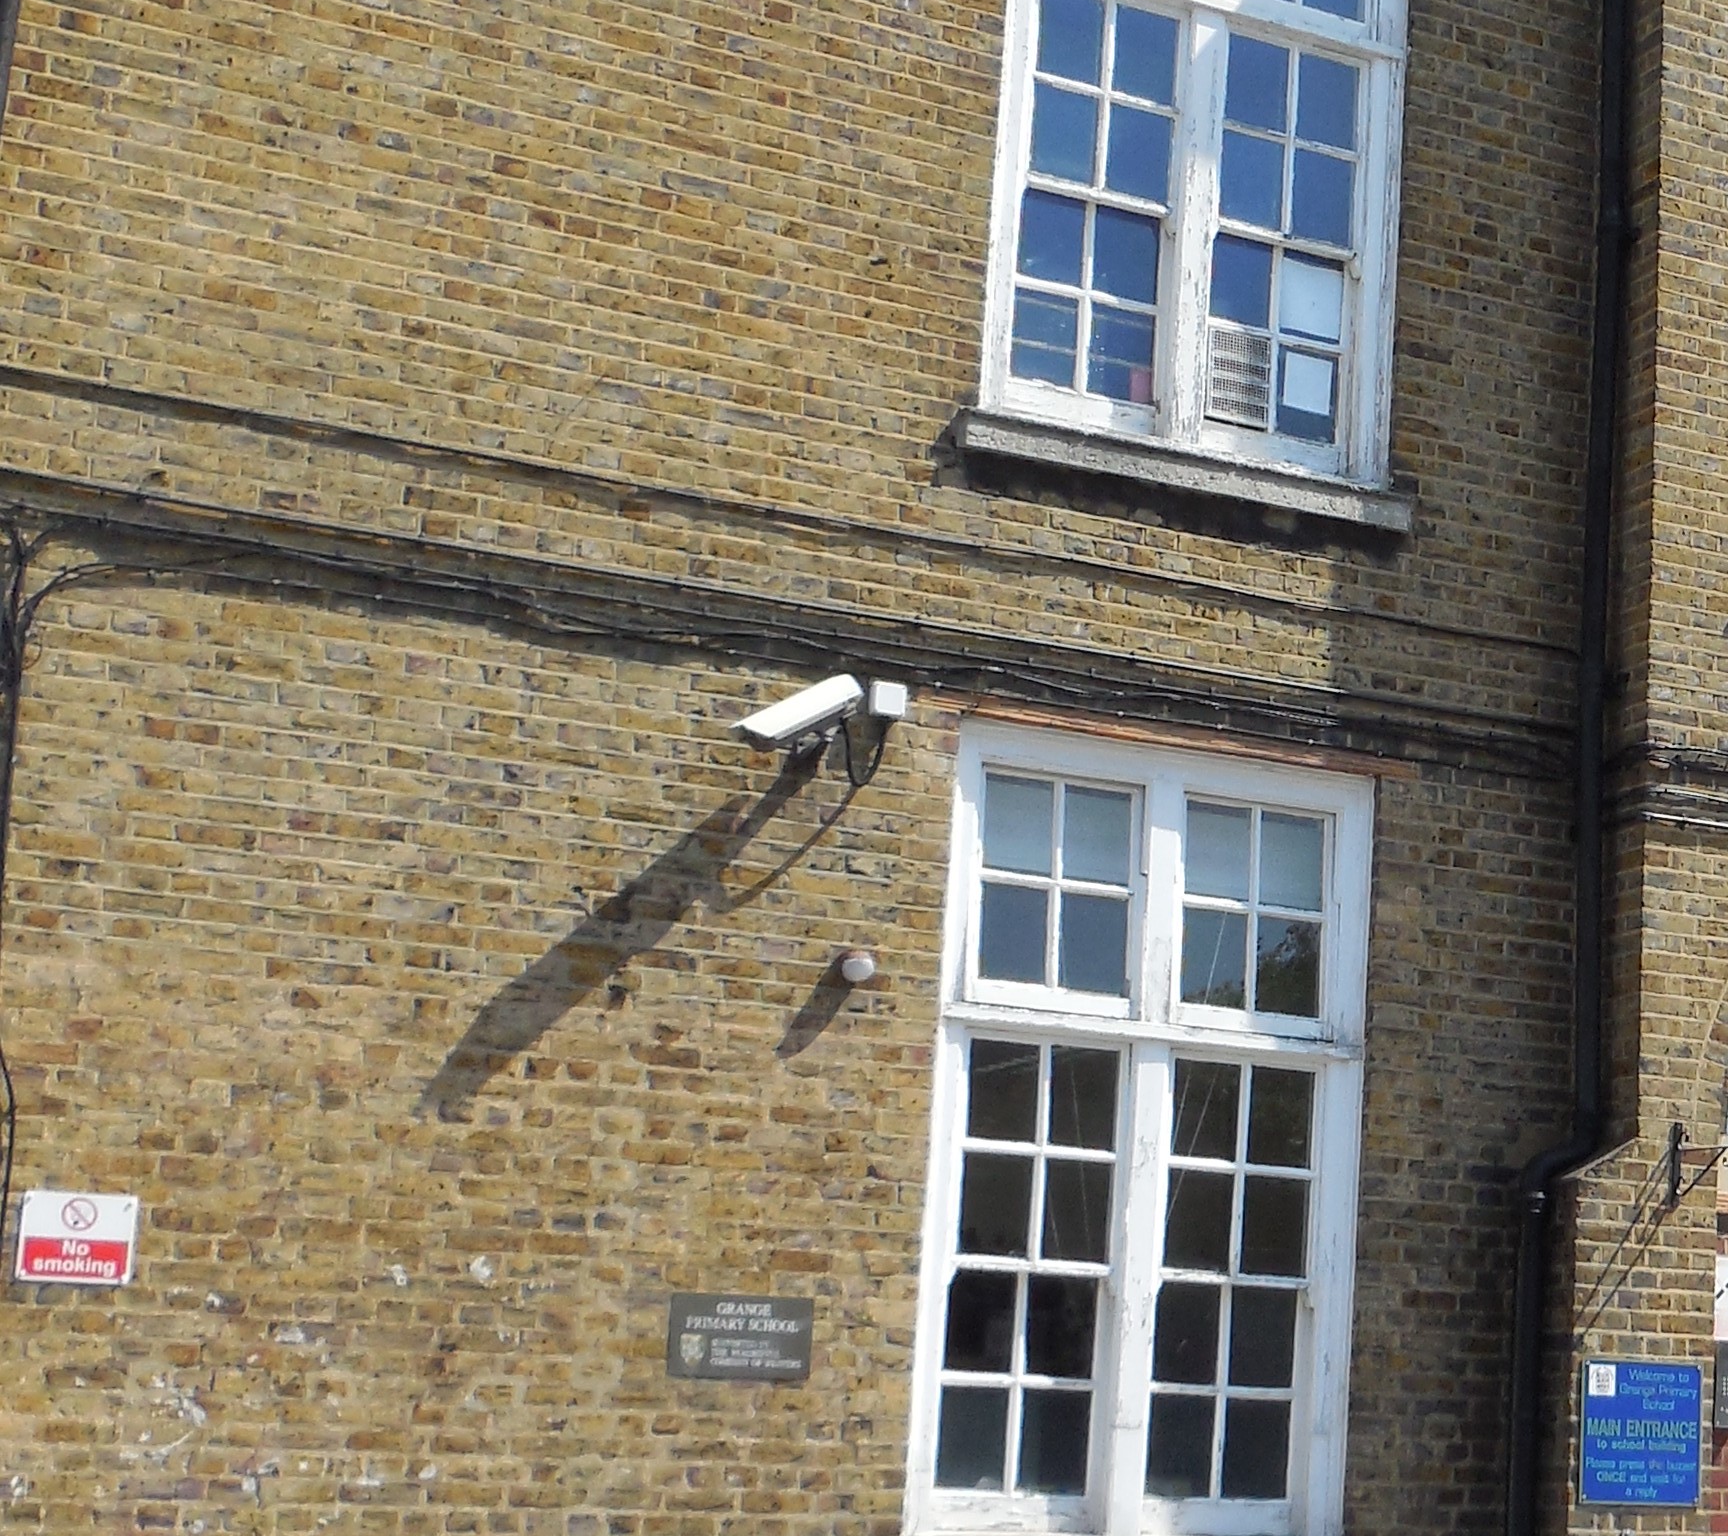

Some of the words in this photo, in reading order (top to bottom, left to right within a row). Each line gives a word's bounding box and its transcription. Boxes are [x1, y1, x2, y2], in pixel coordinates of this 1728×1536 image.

[62, 1240, 90, 1256] No
[33, 1257, 116, 1277] smoking
[716, 1301, 772, 1317] GRANGE
[685, 1315, 746, 1331] PRIMARY
[748, 1318, 799, 1333] SCHOOL
[1629, 1368, 1675, 1382] Welcome
[1678, 1372, 1690, 1382] to
[1619, 1383, 1656, 1398] Grange
[1659, 1384, 1697, 1400] Primary
[1642, 1399, 1675, 1410] School
[1586, 1417, 1621, 1436] MAIN
[1626, 1419, 1697, 1439] ENTRANCE
[1597, 1439, 1608, 1449] to
[1611, 1439, 1645, 1450] school
[1648, 1439, 1686, 1454] building
[1596, 1470, 1626, 1482] ONCE
